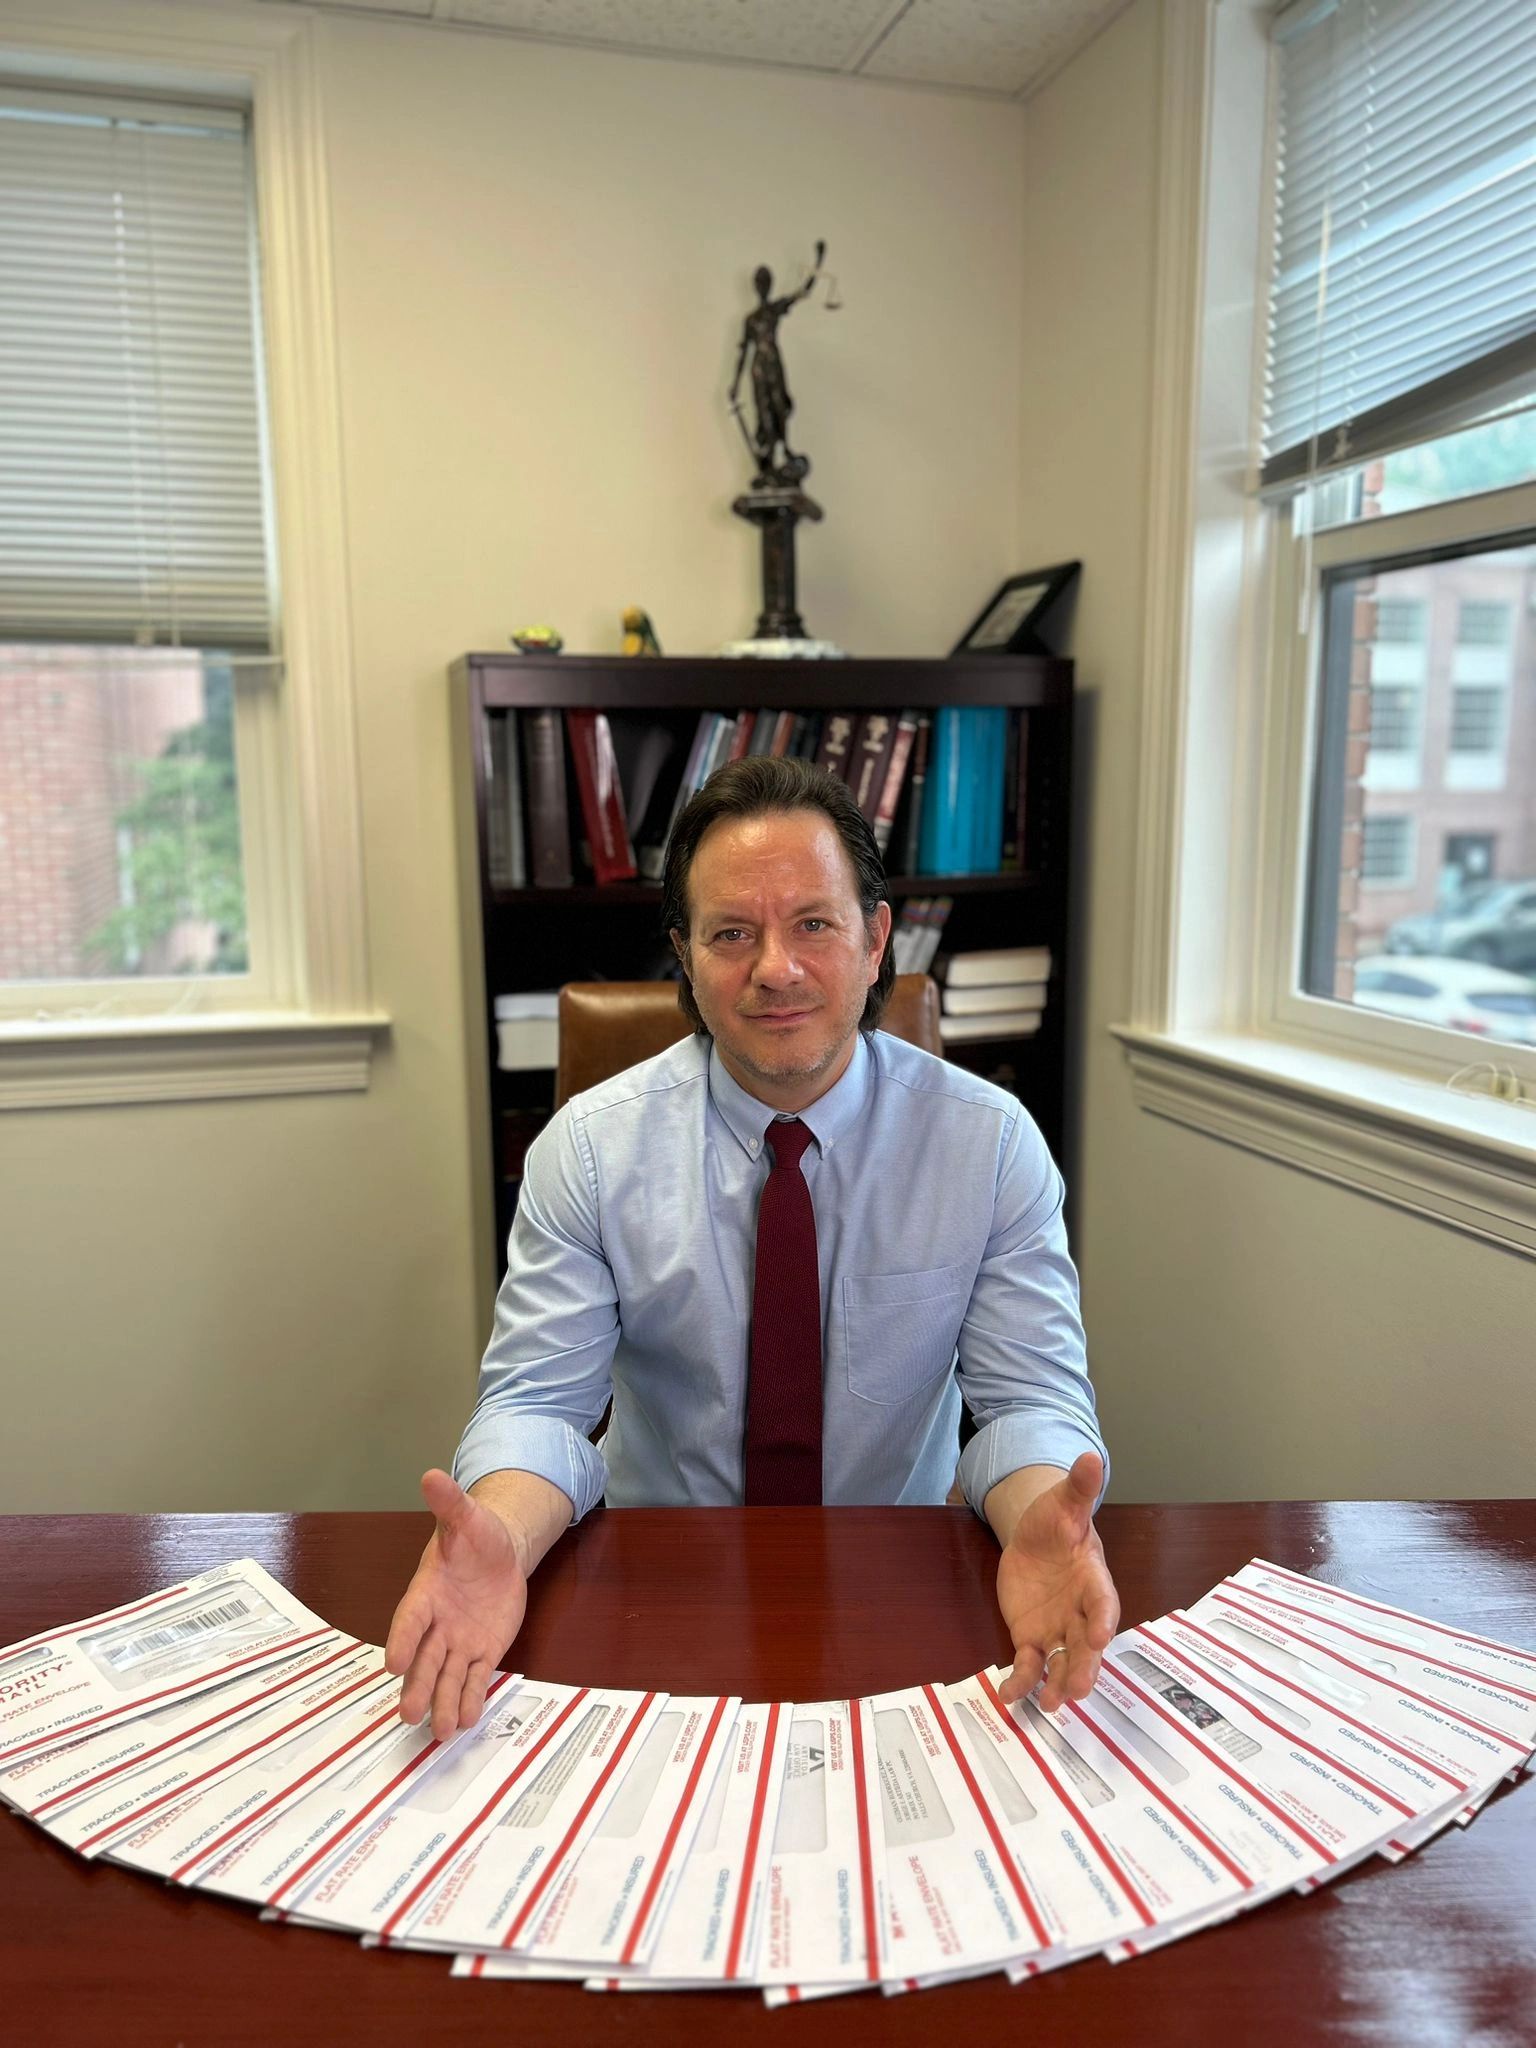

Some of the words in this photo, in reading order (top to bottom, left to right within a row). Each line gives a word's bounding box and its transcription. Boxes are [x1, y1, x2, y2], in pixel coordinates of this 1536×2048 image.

[1454, 1641, 1501, 1660] INSURED
[1422, 1667, 1470, 1688] INSURED
[3, 1702, 33, 1719] RATE
[34, 1681, 91, 1705] ENVELOPE
[53, 1704, 104, 1726] INSURED
[1398, 1699, 1443, 1724] INSURED
[1478, 1688, 1531, 1712] TRACKED
[1338, 1727, 1382, 1755] INSURED
[1450, 1725, 1502, 1755] TRACKED
[36, 1770, 89, 1798] TRACKED
[97, 1742, 145, 1767] INSURED
[1289, 1751, 1332, 1782] INSURED
[1388, 1756, 1437, 1790] TRACKED
[80, 1801, 134, 1832] TRACKED
[141, 1771, 188, 1798] INSURED
[1218, 1784, 1258, 1818] INSURED
[1336, 1782, 1383, 1816] TRACKED
[128, 1827, 153, 1847] FLAT
[170, 1825, 219, 1861] TRACKED
[224, 1789, 267, 1820] INSURED
[1143, 1806, 1180, 1840] INSURED
[1260, 1820, 1304, 1860] TRACKED
[260, 1847, 304, 1886] TRACKED
[307, 1809, 345, 1842] INSURED
[335, 1856, 359, 1877] RATE
[356, 1816, 396, 1854] ENVELOPE
[1061, 1829, 1090, 1869] INSURED
[371, 1872, 411, 1912] TRACKED
[412, 1832, 446, 1866] INSURED
[909, 1856, 933, 1903] ENVELOPE
[1180, 1844, 1221, 1884] TRACKED
[1089, 1874, 1122, 1918] TRACKED
